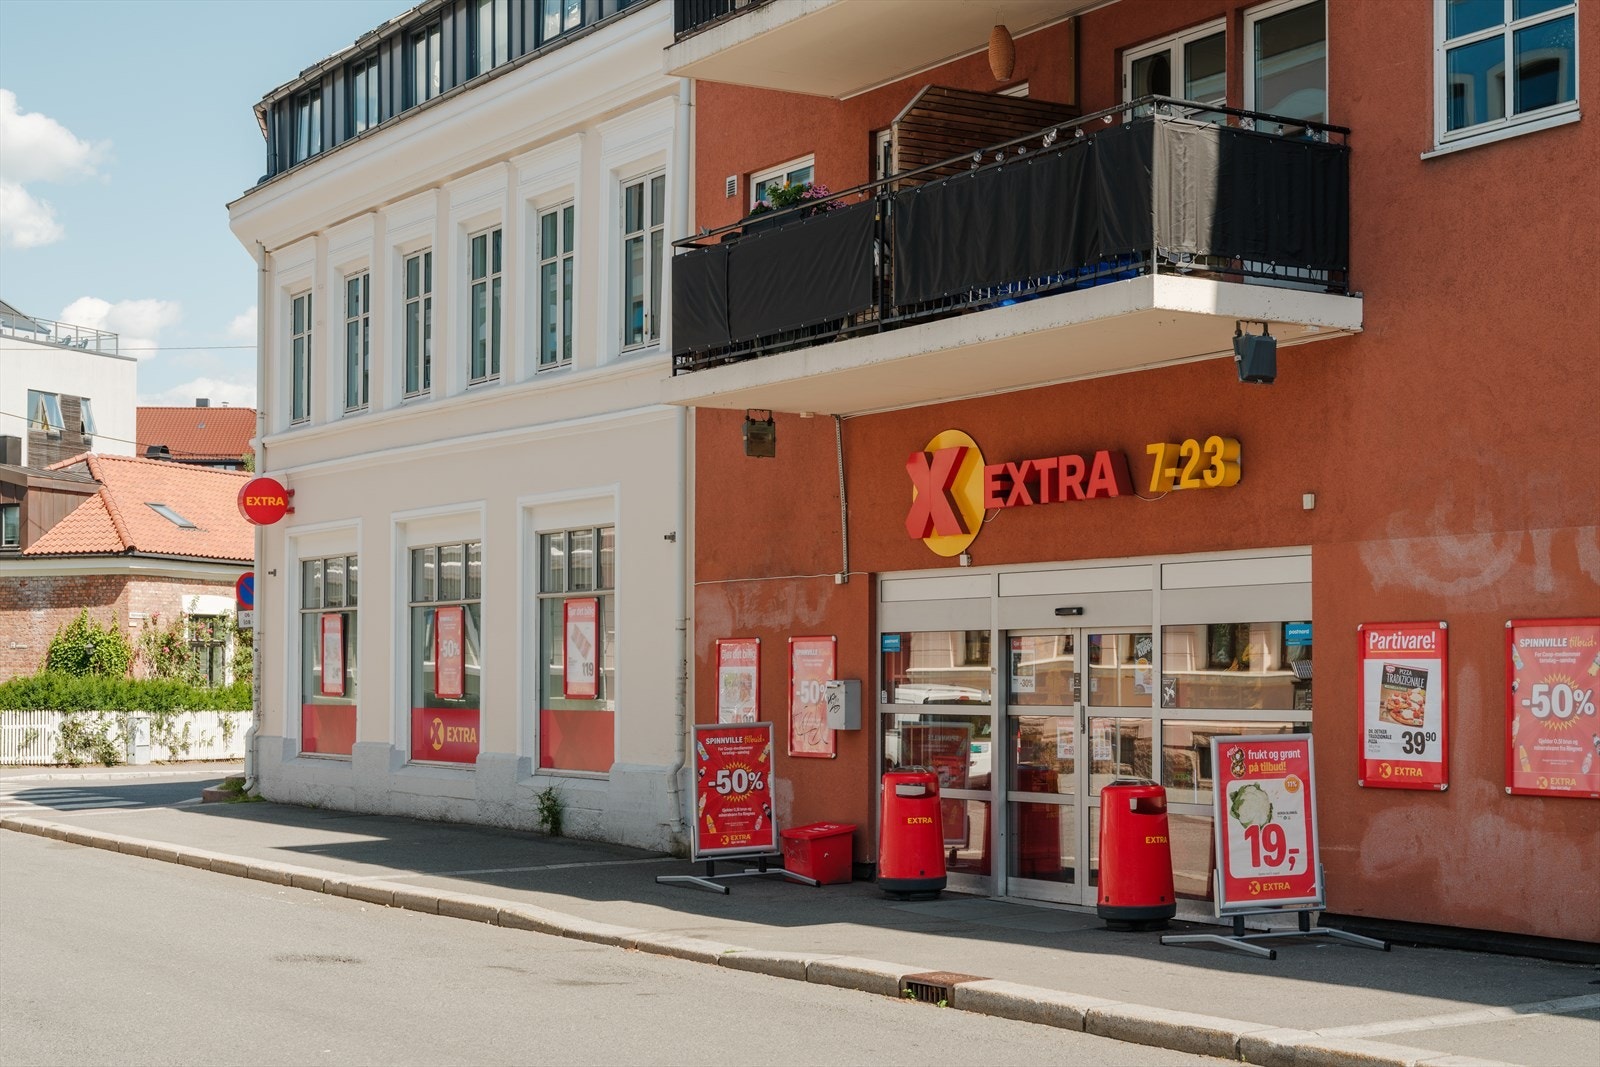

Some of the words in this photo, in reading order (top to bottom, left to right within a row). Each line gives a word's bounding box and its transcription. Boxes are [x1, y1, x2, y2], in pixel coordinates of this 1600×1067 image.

[984, 450, 1120, 509] EXTRA
[1146, 435, 1229, 492] 7-23
[246, 496, 285, 507] EXTRA
[1288, 628, 1310, 636] postnord
[1369, 631, 1436, 650] Partivare!
[1520, 637, 1568, 648] SPINNVILLE
[1386, 673, 1425, 688] TRADIZIONALE
[1521, 683, 1595, 719] -50%
[446, 726, 477, 744] EXTRA
[705, 736, 743, 745] SPINNVILLE
[1248, 750, 1268, 760] frukt
[1269, 752, 1279, 762] og
[1280, 749, 1301, 761] grønt
[1248, 762, 1259, 774] på
[1260, 761, 1287, 772] tilbud!
[1394, 767, 1423, 777] EXTRA
[708, 768, 764, 796] -50%
[1550, 777, 1577, 786] EXTRA
[1145, 836, 1168, 844] EXTRA
[1262, 882, 1291, 892] EXTRA
